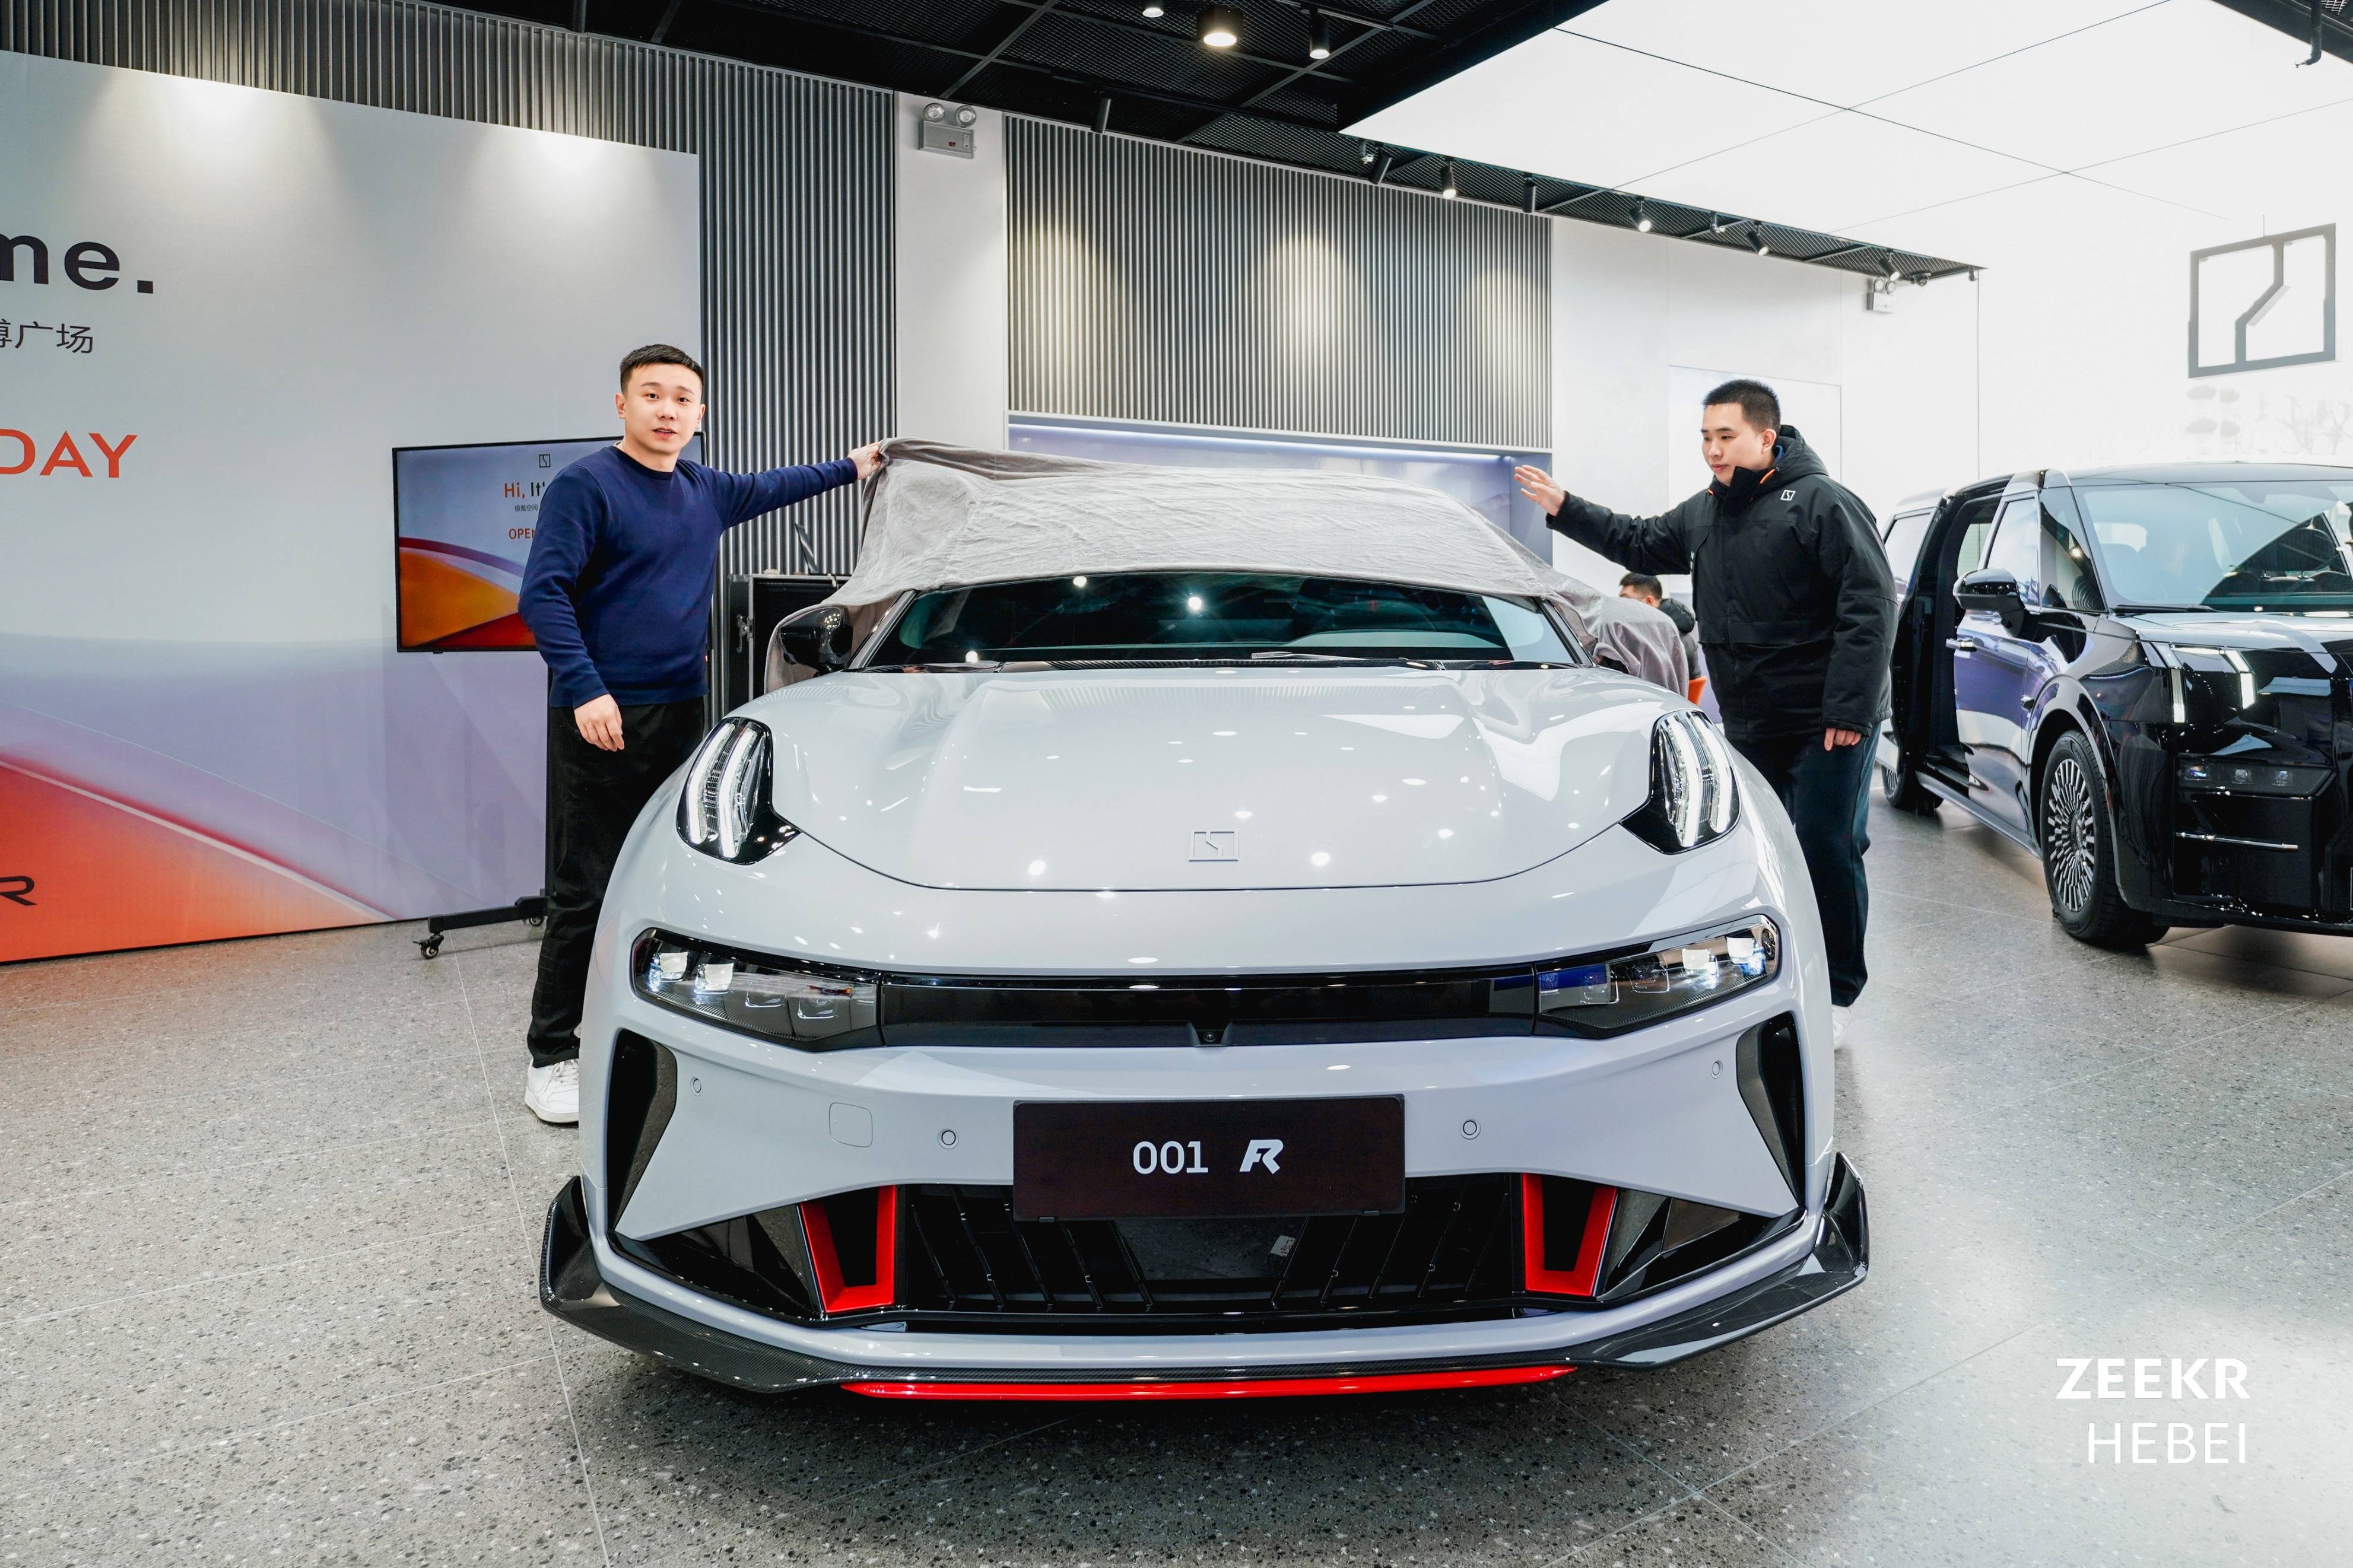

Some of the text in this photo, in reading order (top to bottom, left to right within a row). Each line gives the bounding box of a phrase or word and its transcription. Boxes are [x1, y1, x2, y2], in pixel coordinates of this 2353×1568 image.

[0, 428, 138, 478] DAY
[504, 482, 525, 499] Hi,
[1132, 1139, 1284, 1175] 001 R
